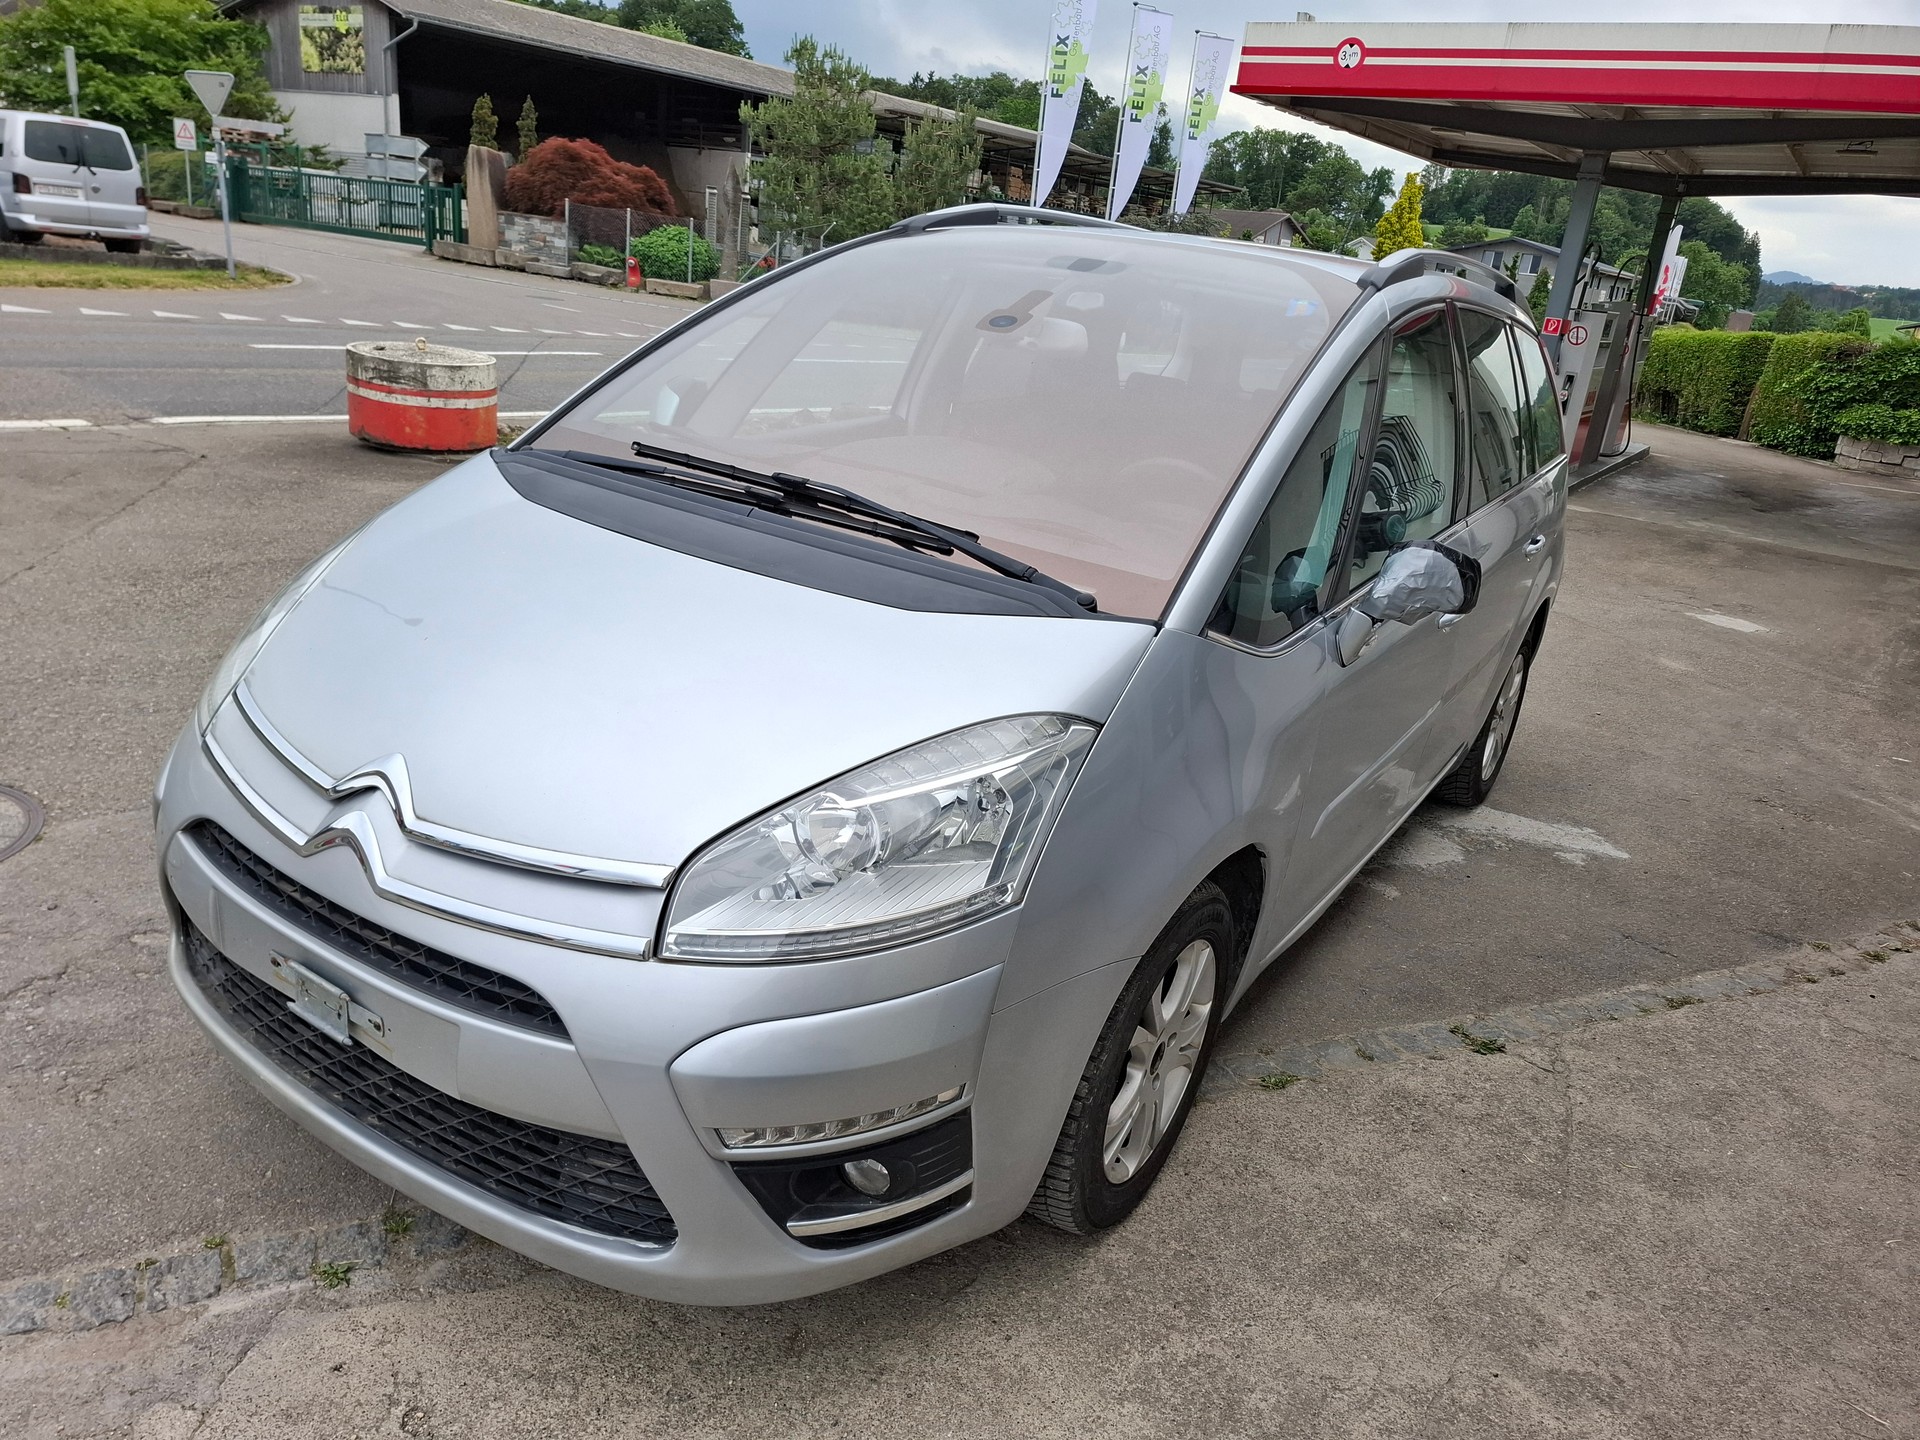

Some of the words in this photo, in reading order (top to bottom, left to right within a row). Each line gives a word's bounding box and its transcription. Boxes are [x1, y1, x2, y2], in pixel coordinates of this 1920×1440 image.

[1069, 8, 1083, 56] Gartenbau
[1153, 25, 1161, 40] AG
[1050, 34, 1070, 98] FELIX
[1147, 41, 1160, 86] Gartenbau
[1203, 65, 1217, 107] Gartenbau
[1212, 50, 1220, 65] AG
[1129, 64, 1149, 123] FELIX
[1188, 87, 1206, 141] FELIX
